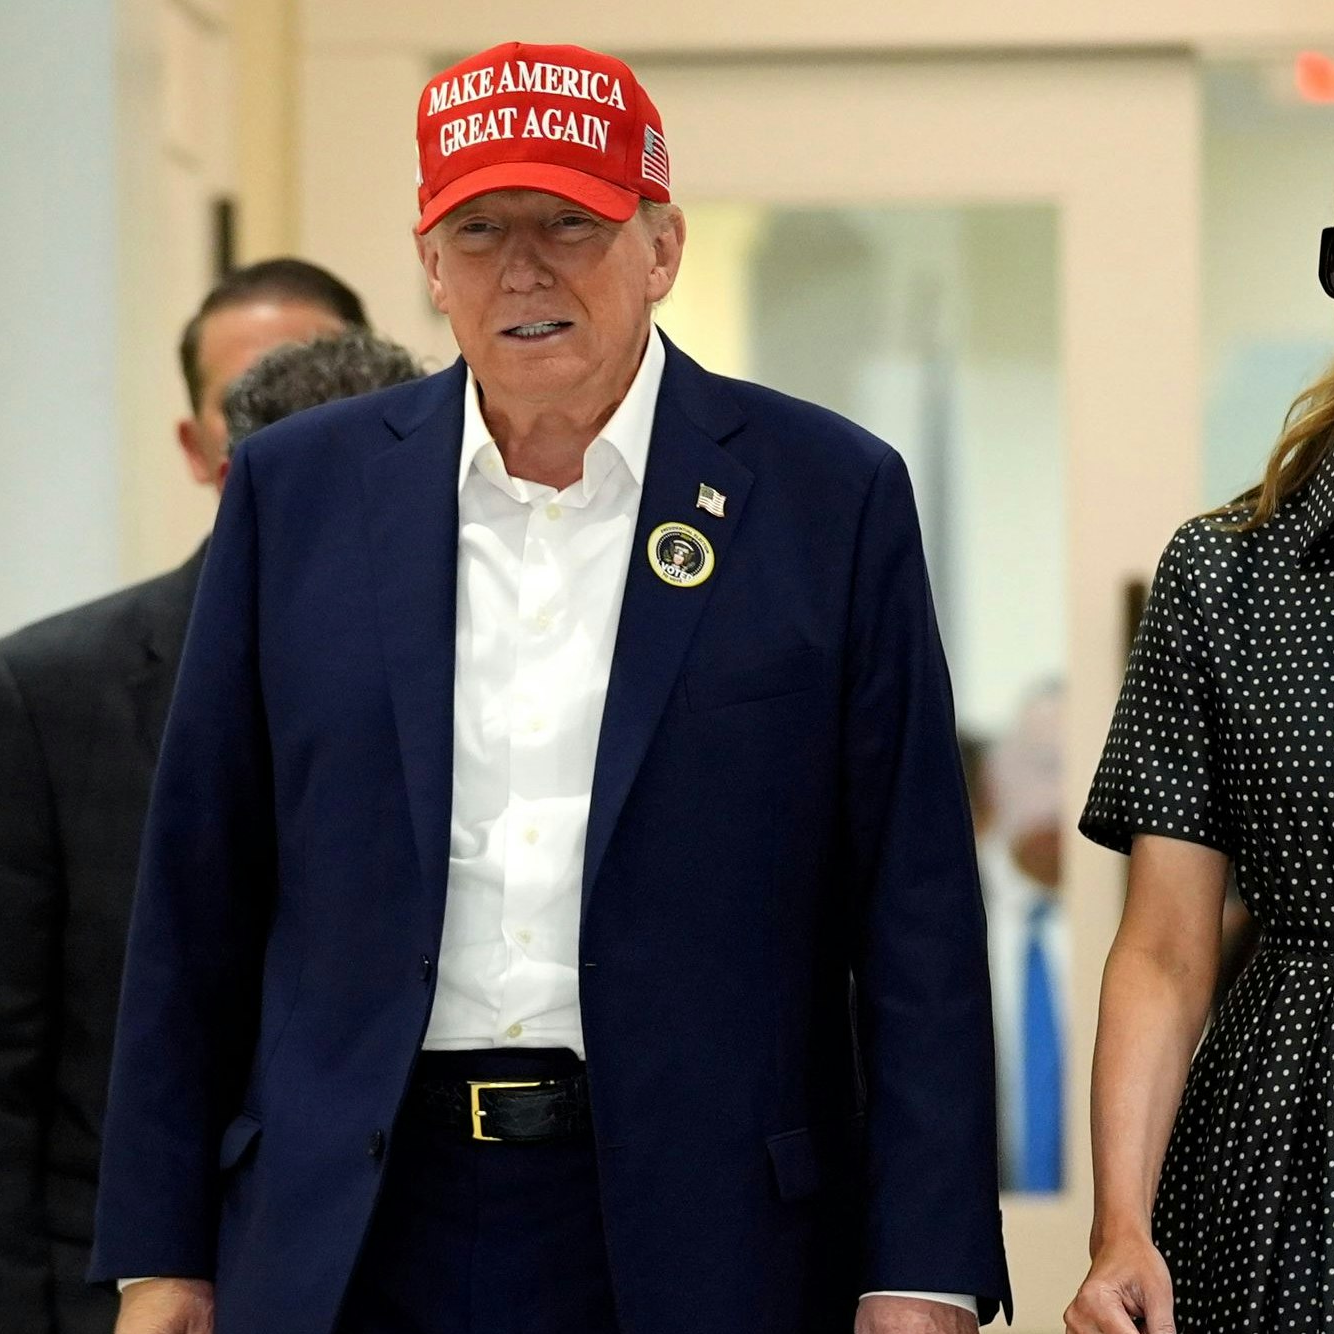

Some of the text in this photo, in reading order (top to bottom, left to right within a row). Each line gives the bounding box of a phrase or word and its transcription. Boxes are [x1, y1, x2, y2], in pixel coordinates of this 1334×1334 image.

[427, 61, 627, 116] MAKE AMERICA
[440, 107, 610, 157] GREAT AGAIN
[693, 533, 709, 554] ELECTION
[661, 561, 693, 581] VOTED
